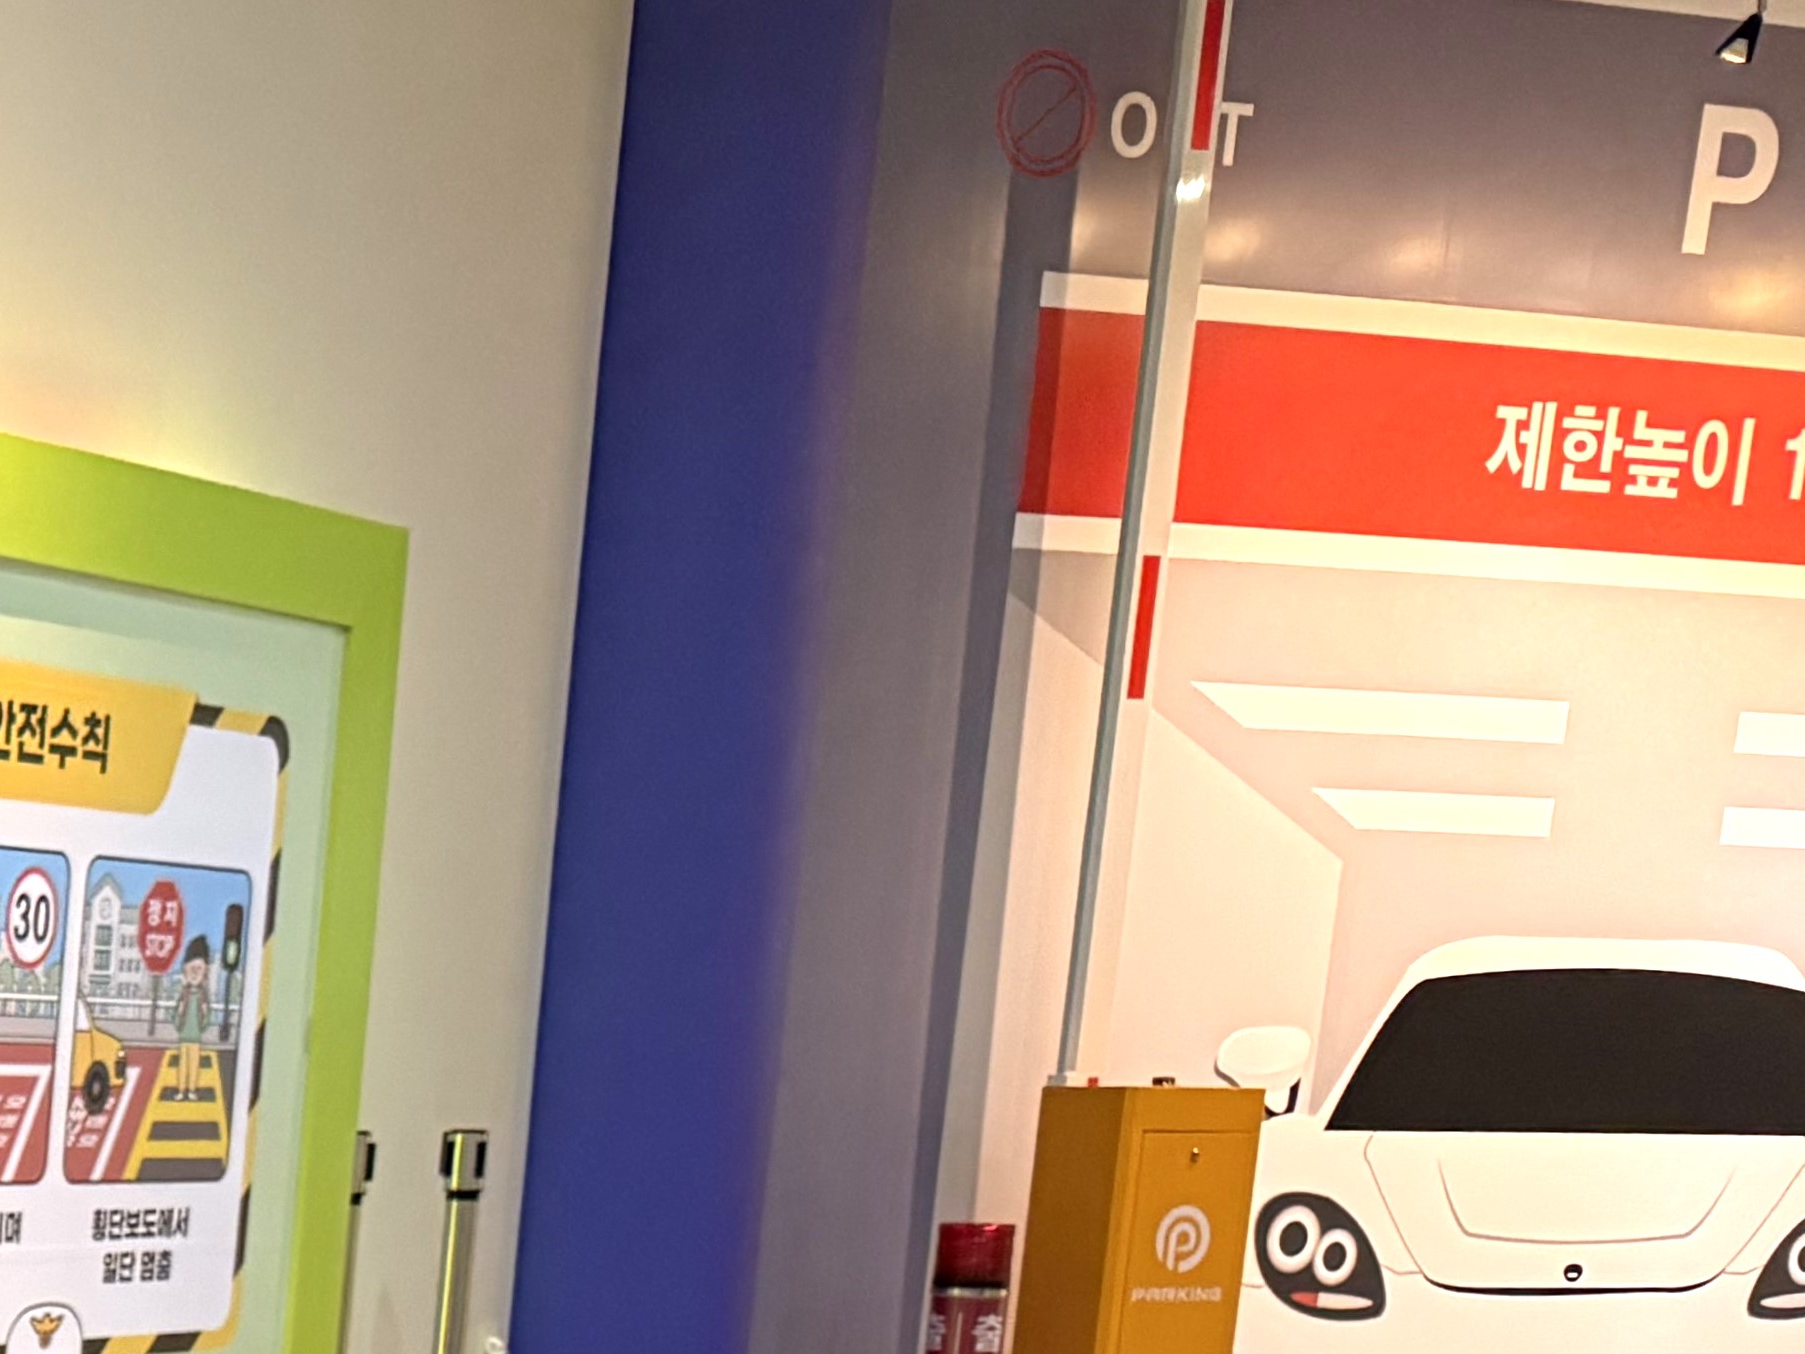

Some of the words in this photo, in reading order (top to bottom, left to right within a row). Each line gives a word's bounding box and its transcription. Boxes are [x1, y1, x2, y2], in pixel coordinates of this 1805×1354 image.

[1111, 91, 1254, 167] OT
[1484, 400, 1757, 507] 제한높이
[13, 892, 51, 945] 30
[92, 1206, 191, 1243] 횡단보도에서
[101, 1250, 136, 1285] 일단
[139, 1249, 173, 1283] 멈춤
